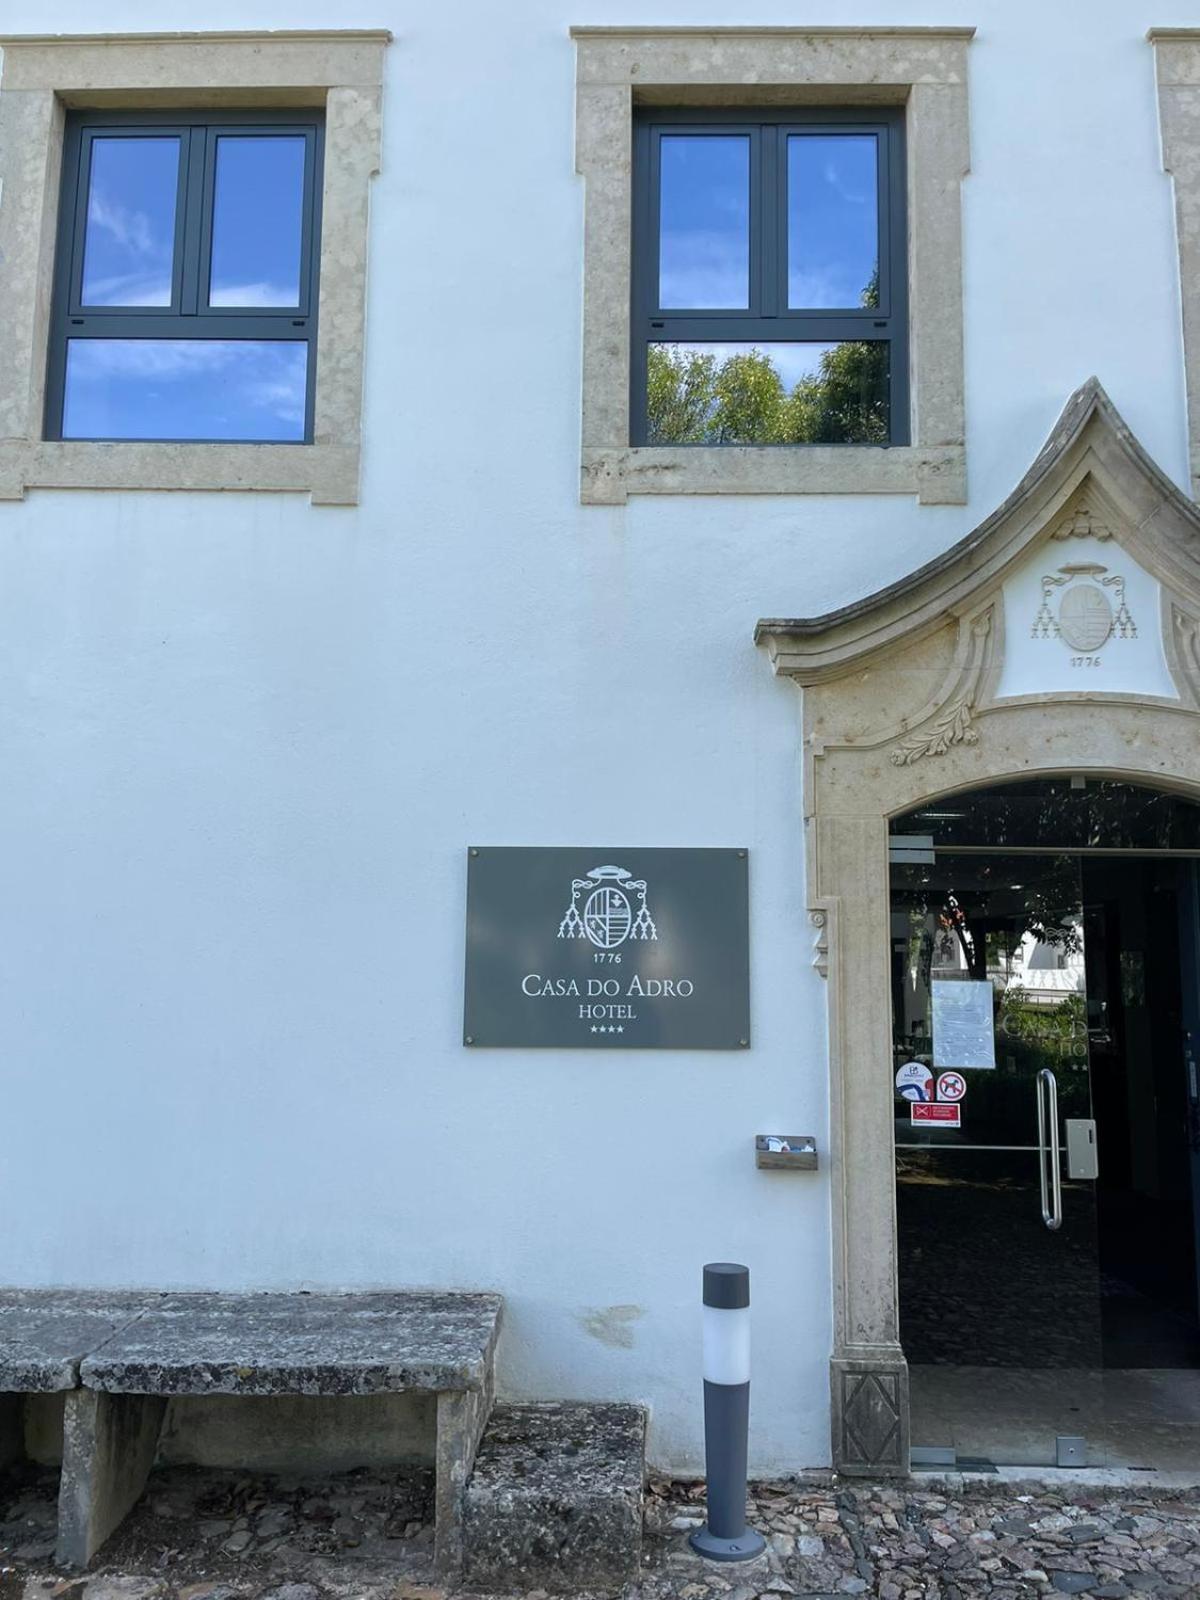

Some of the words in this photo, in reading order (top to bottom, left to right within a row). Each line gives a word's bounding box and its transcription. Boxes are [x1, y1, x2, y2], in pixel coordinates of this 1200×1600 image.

[1070, 656, 1102, 667] 1776
[593, 953, 622, 964] 1776
[521, 974, 581, 997] CASA
[587, 979, 620, 997] DO
[625, 974, 694, 997] ADRO
[578, 1004, 637, 1019] HOTEL
